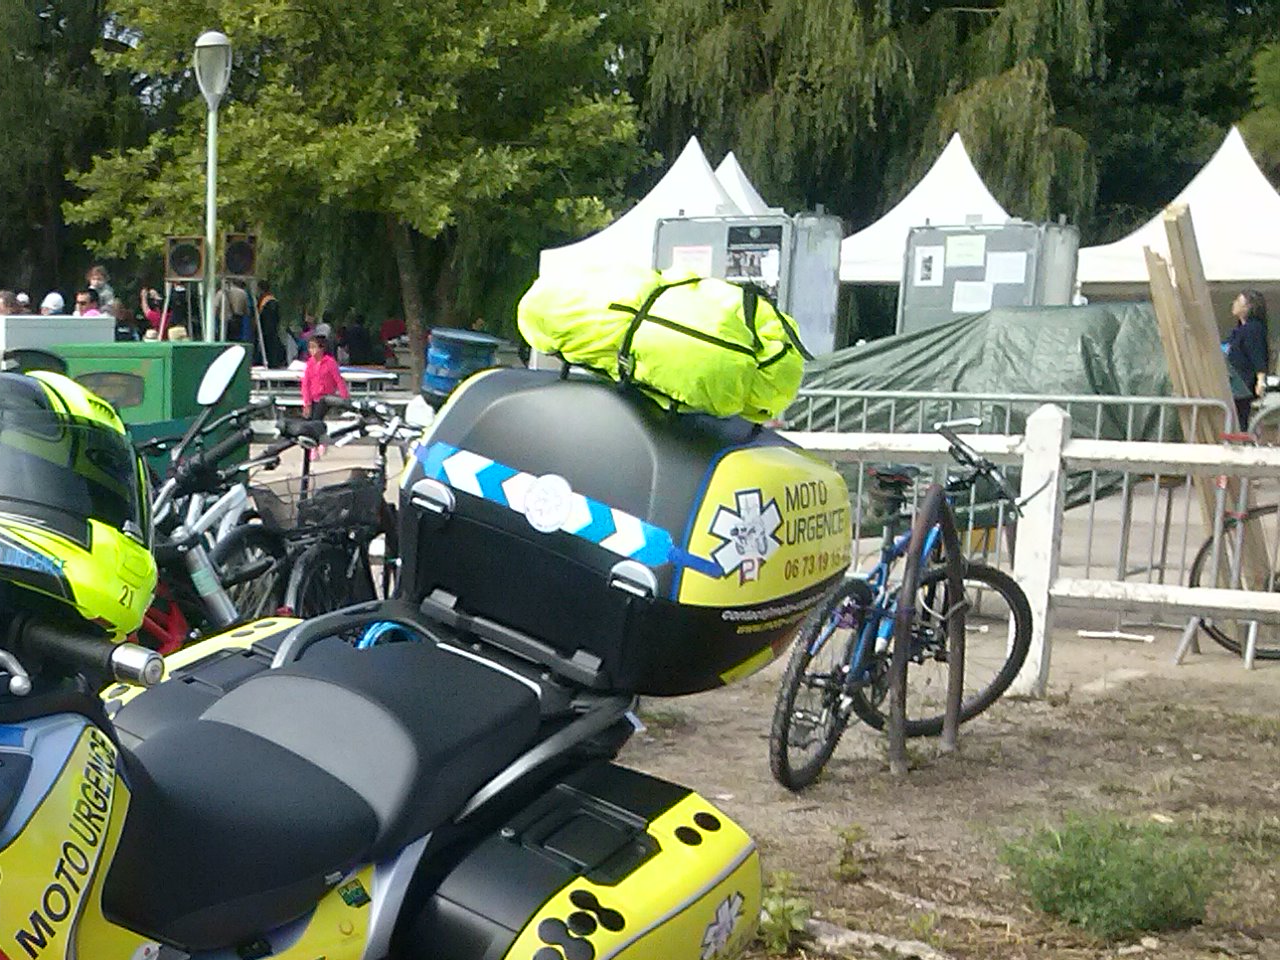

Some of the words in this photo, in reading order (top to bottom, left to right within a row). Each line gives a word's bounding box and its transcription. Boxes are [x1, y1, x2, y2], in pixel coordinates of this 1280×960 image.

[784, 480, 827, 513] MOTO
[786, 507, 845, 547] URGENCE
[784, 559, 799, 581] 06
[803, 554, 815, 575] 73
[119, 585, 134, 610] 21
[14, 840, 90, 960] MOTO
[68, 731, 116, 847] URGENCE
